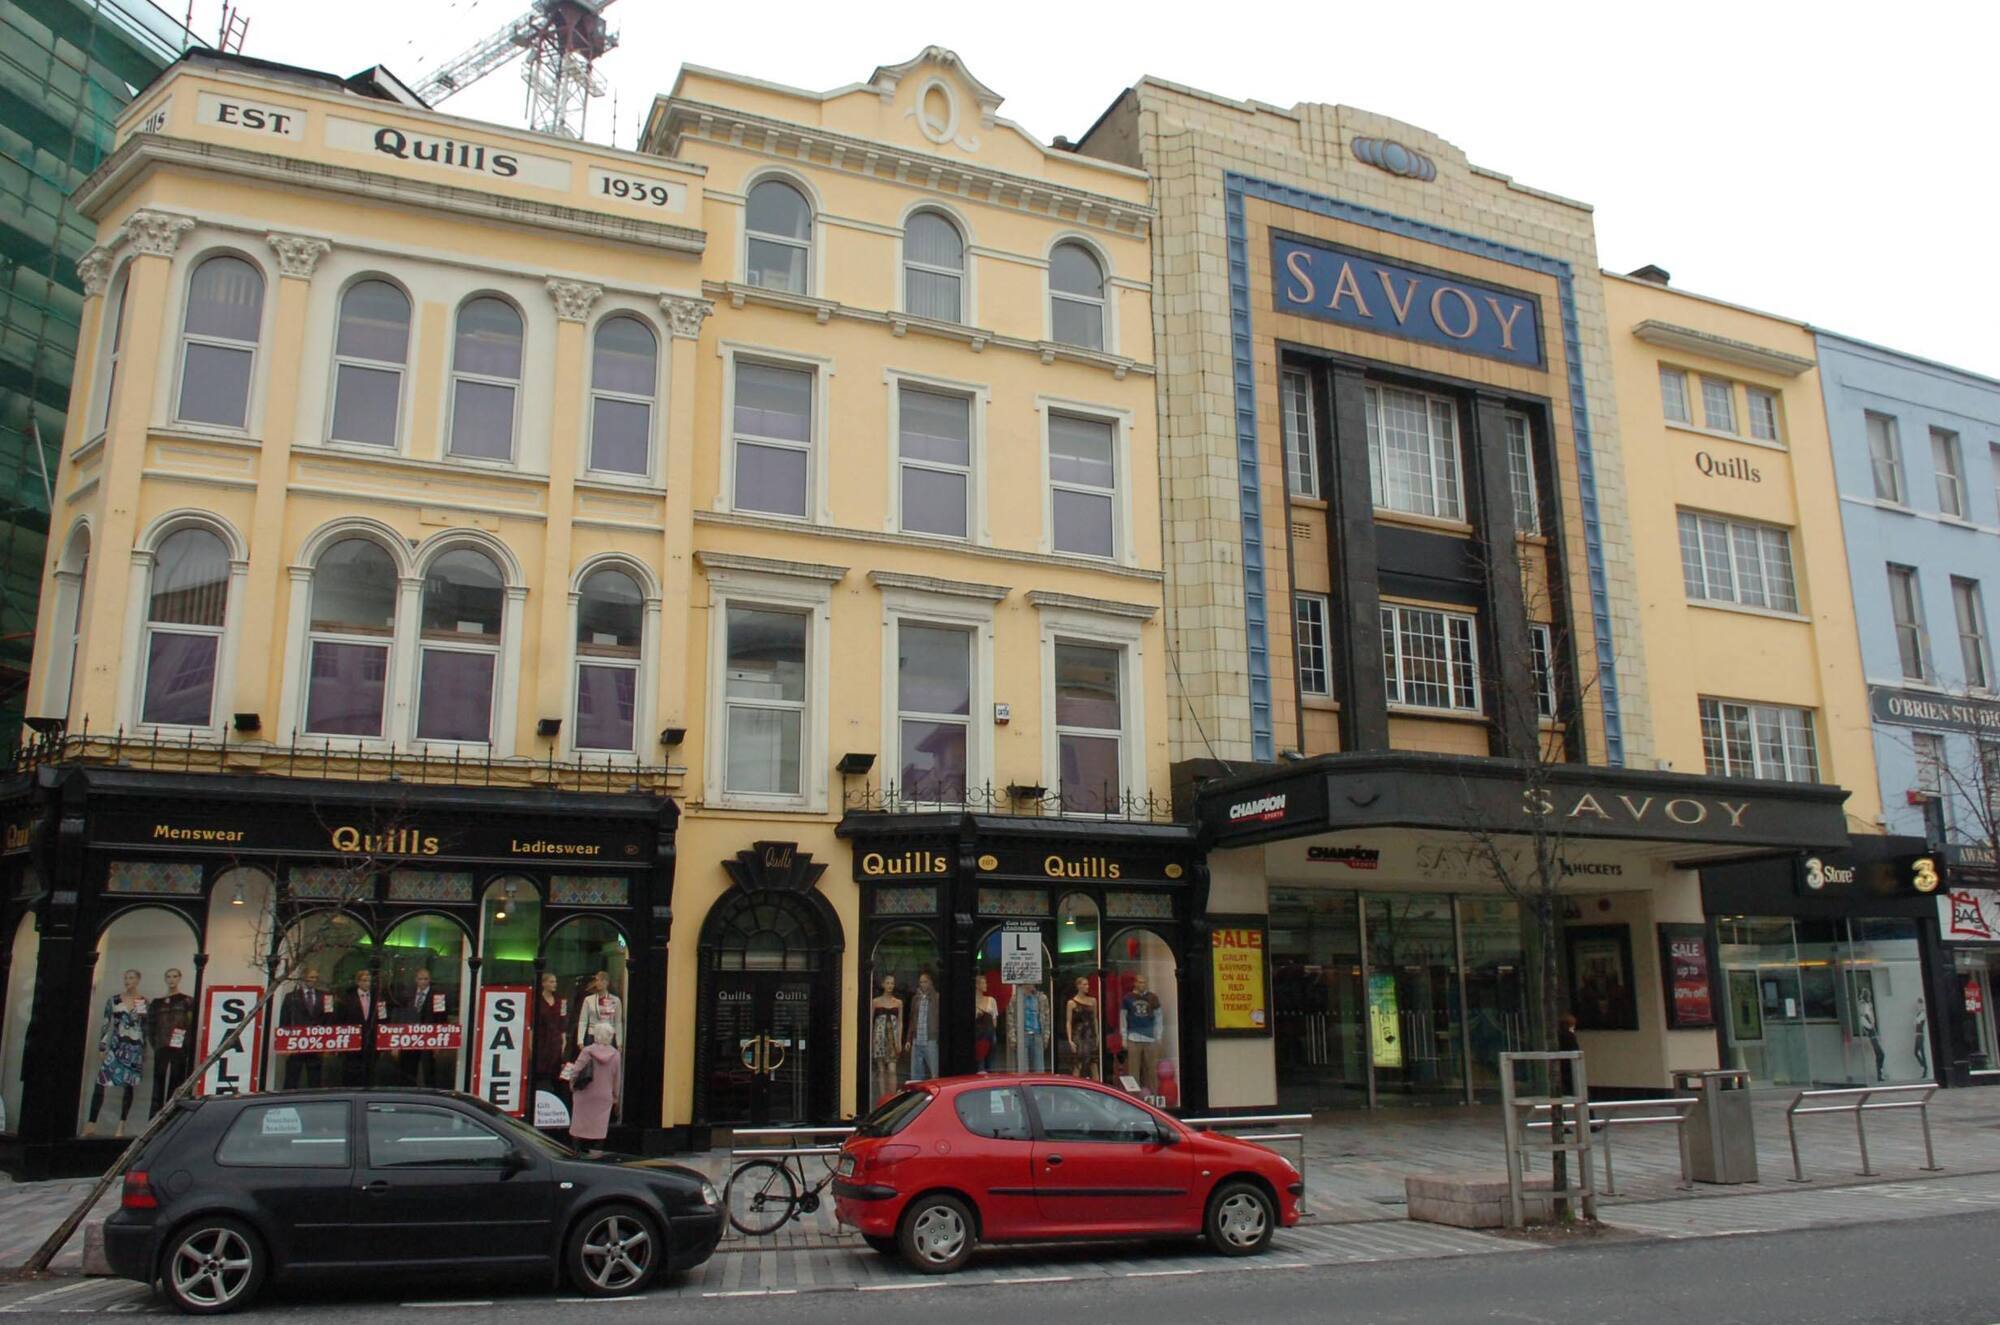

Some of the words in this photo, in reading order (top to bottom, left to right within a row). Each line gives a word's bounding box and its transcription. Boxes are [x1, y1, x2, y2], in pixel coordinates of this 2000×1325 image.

[217, 103, 291, 135] EST.
[373, 128, 518, 177] Quills
[602, 176, 669, 206] 1939
[1286, 250, 1524, 350] SAVOY
[1695, 450, 1762, 483] Quills
[1888, 697, 1949, 720] O'BRIEN
[1229, 794, 1286, 818] CHAMPION
[1522, 788, 1750, 828] SAVOY
[153, 825, 245, 842] Menswear
[331, 826, 440, 855] Quills
[511, 839, 600, 855] Ladieswear
[765, 846, 793, 868] Quills
[1308, 845, 1380, 861] CHAMPION
[862, 851, 948, 875] Quills
[1044, 855, 1120, 879] Quills
[1573, 863, 1623, 877] HICKEYS
[1805, 857, 1825, 889] 3
[1912, 857, 1939, 893] 3
[1016, 934, 1027, 951] L
[1211, 929, 1263, 949] SALE
[1671, 943, 1700, 957] SALE
[718, 991, 752, 1001] Quills
[775, 991, 808, 1001] Quills
[276, 1027, 300, 1037] Over
[306, 1026, 332, 1036] 1000
[335, 1025, 361, 1036] Suits
[379, 1025, 404, 1034] Over
[407, 1024, 434, 1035] 1000
[436, 1024, 461, 1034] Suits
[390, 1034, 425, 1047] 50%
[426, 1032, 450, 1047] off
[287, 1037, 323, 1049] 50%
[325, 1034, 350, 1049] off
[489, 998, 516, 1106] SALE
